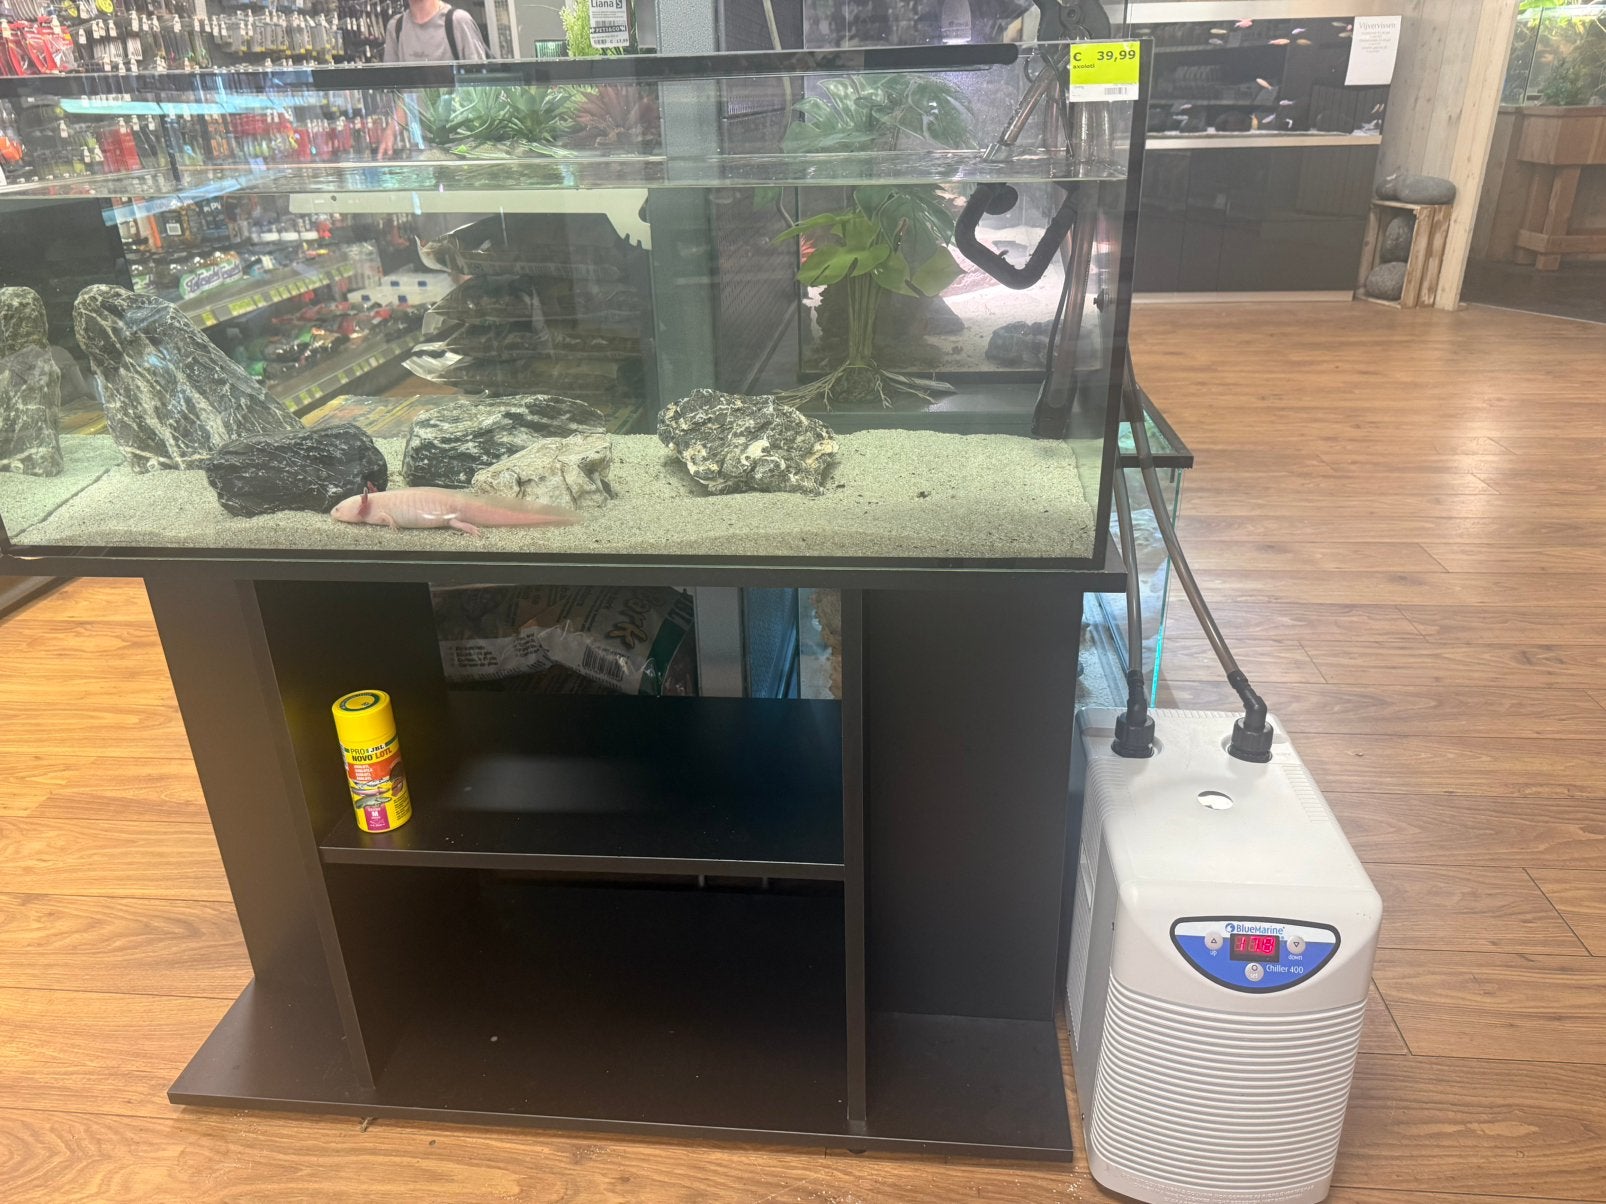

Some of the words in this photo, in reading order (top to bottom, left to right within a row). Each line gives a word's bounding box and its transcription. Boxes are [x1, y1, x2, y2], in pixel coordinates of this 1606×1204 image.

[591, 0, 614, 8] Liana
[1097, 49, 1136, 62] 39,99
[370, 744, 385, 753] JBL
[352, 754, 374, 763] NOVO
[375, 747, 393, 760] LOTL
[1236, 924, 1283, 935] BlueMarine
[1266, 964, 1288, 973] Chiller
[1289, 966, 1304, 974] 400
